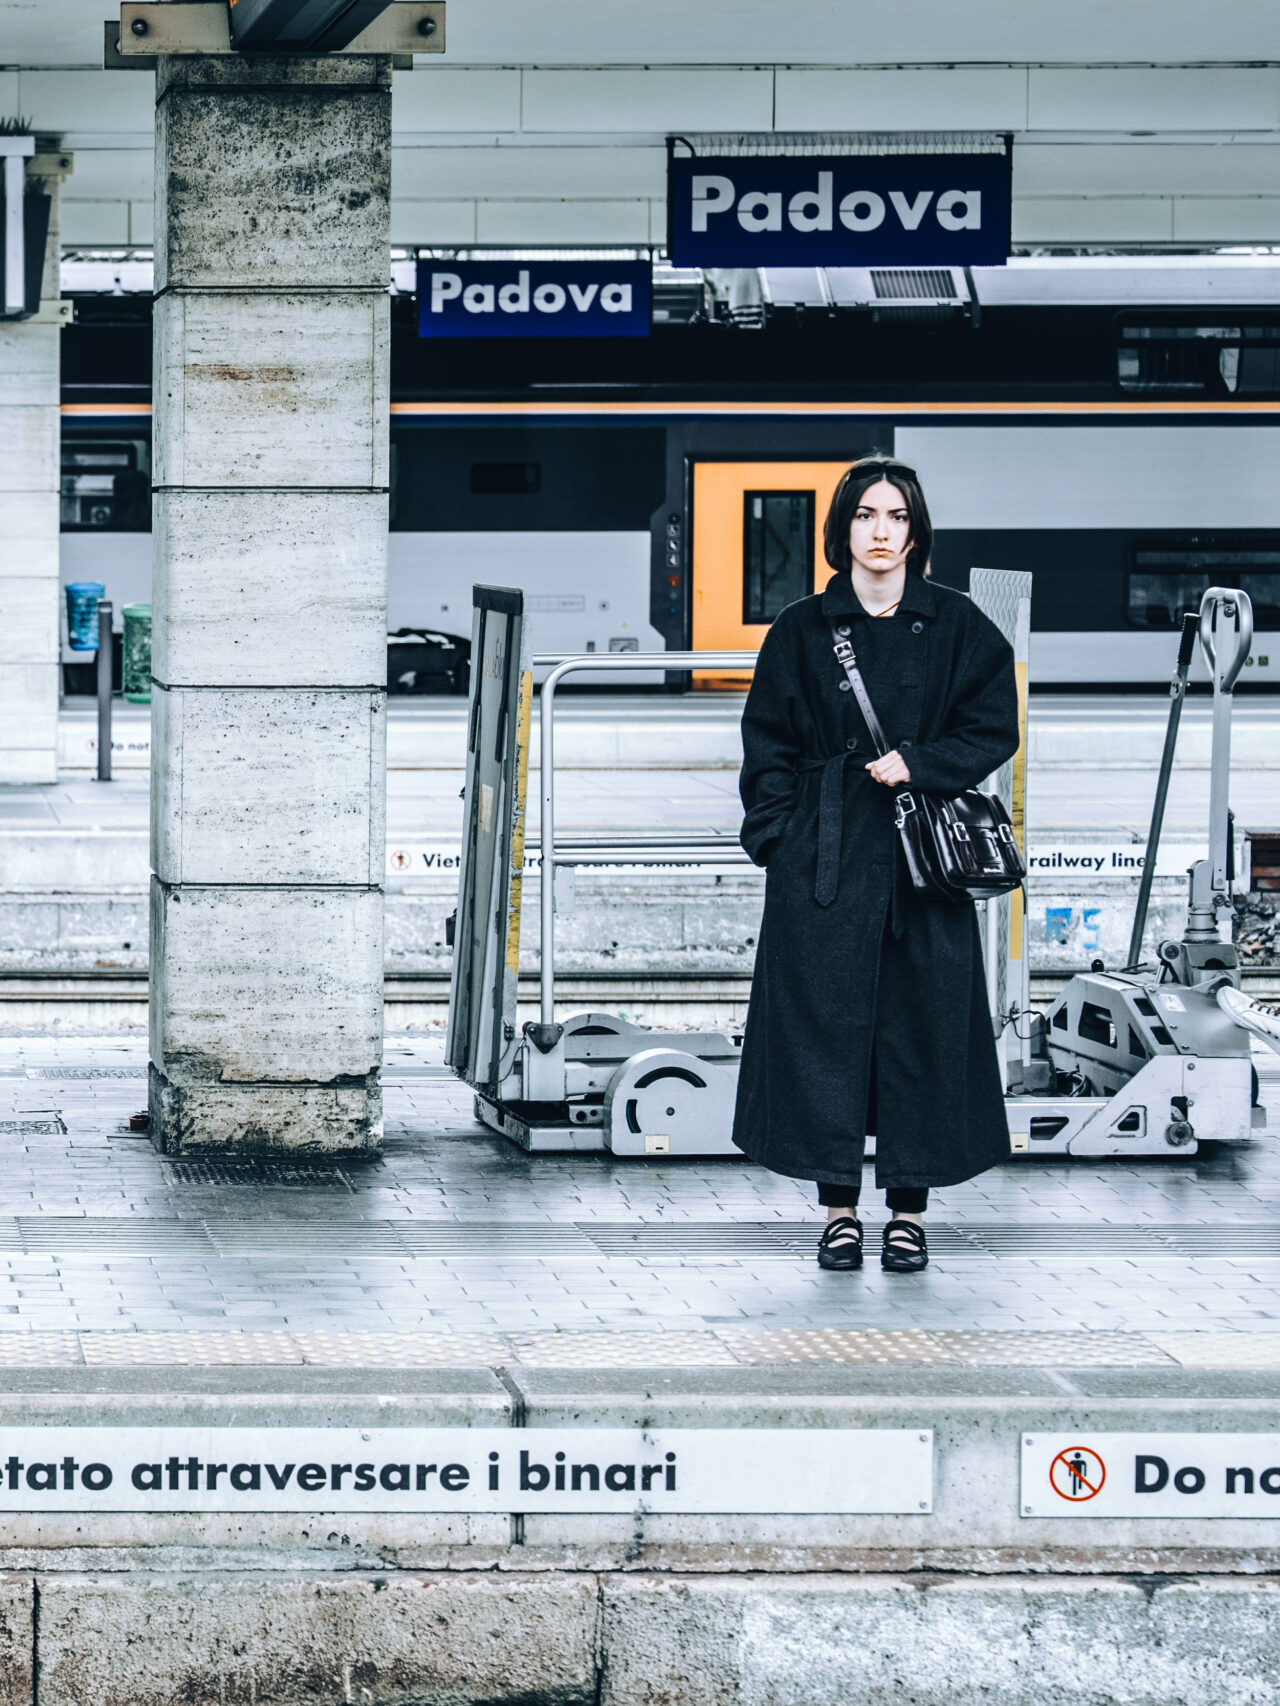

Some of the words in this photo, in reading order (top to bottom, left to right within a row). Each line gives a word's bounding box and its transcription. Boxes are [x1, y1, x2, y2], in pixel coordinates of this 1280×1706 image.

[691, 171, 982, 233] Padova
[431, 270, 632, 315] Padova
[422, 853, 462, 868] Viet
[1029, 852, 1105, 871] railway
[1112, 852, 1157, 868] line
[131, 1457, 470, 1491] attraversare
[490, 1451, 499, 1491] i
[520, 1450, 677, 1492] binari
[1134, 1454, 1206, 1495] Do
